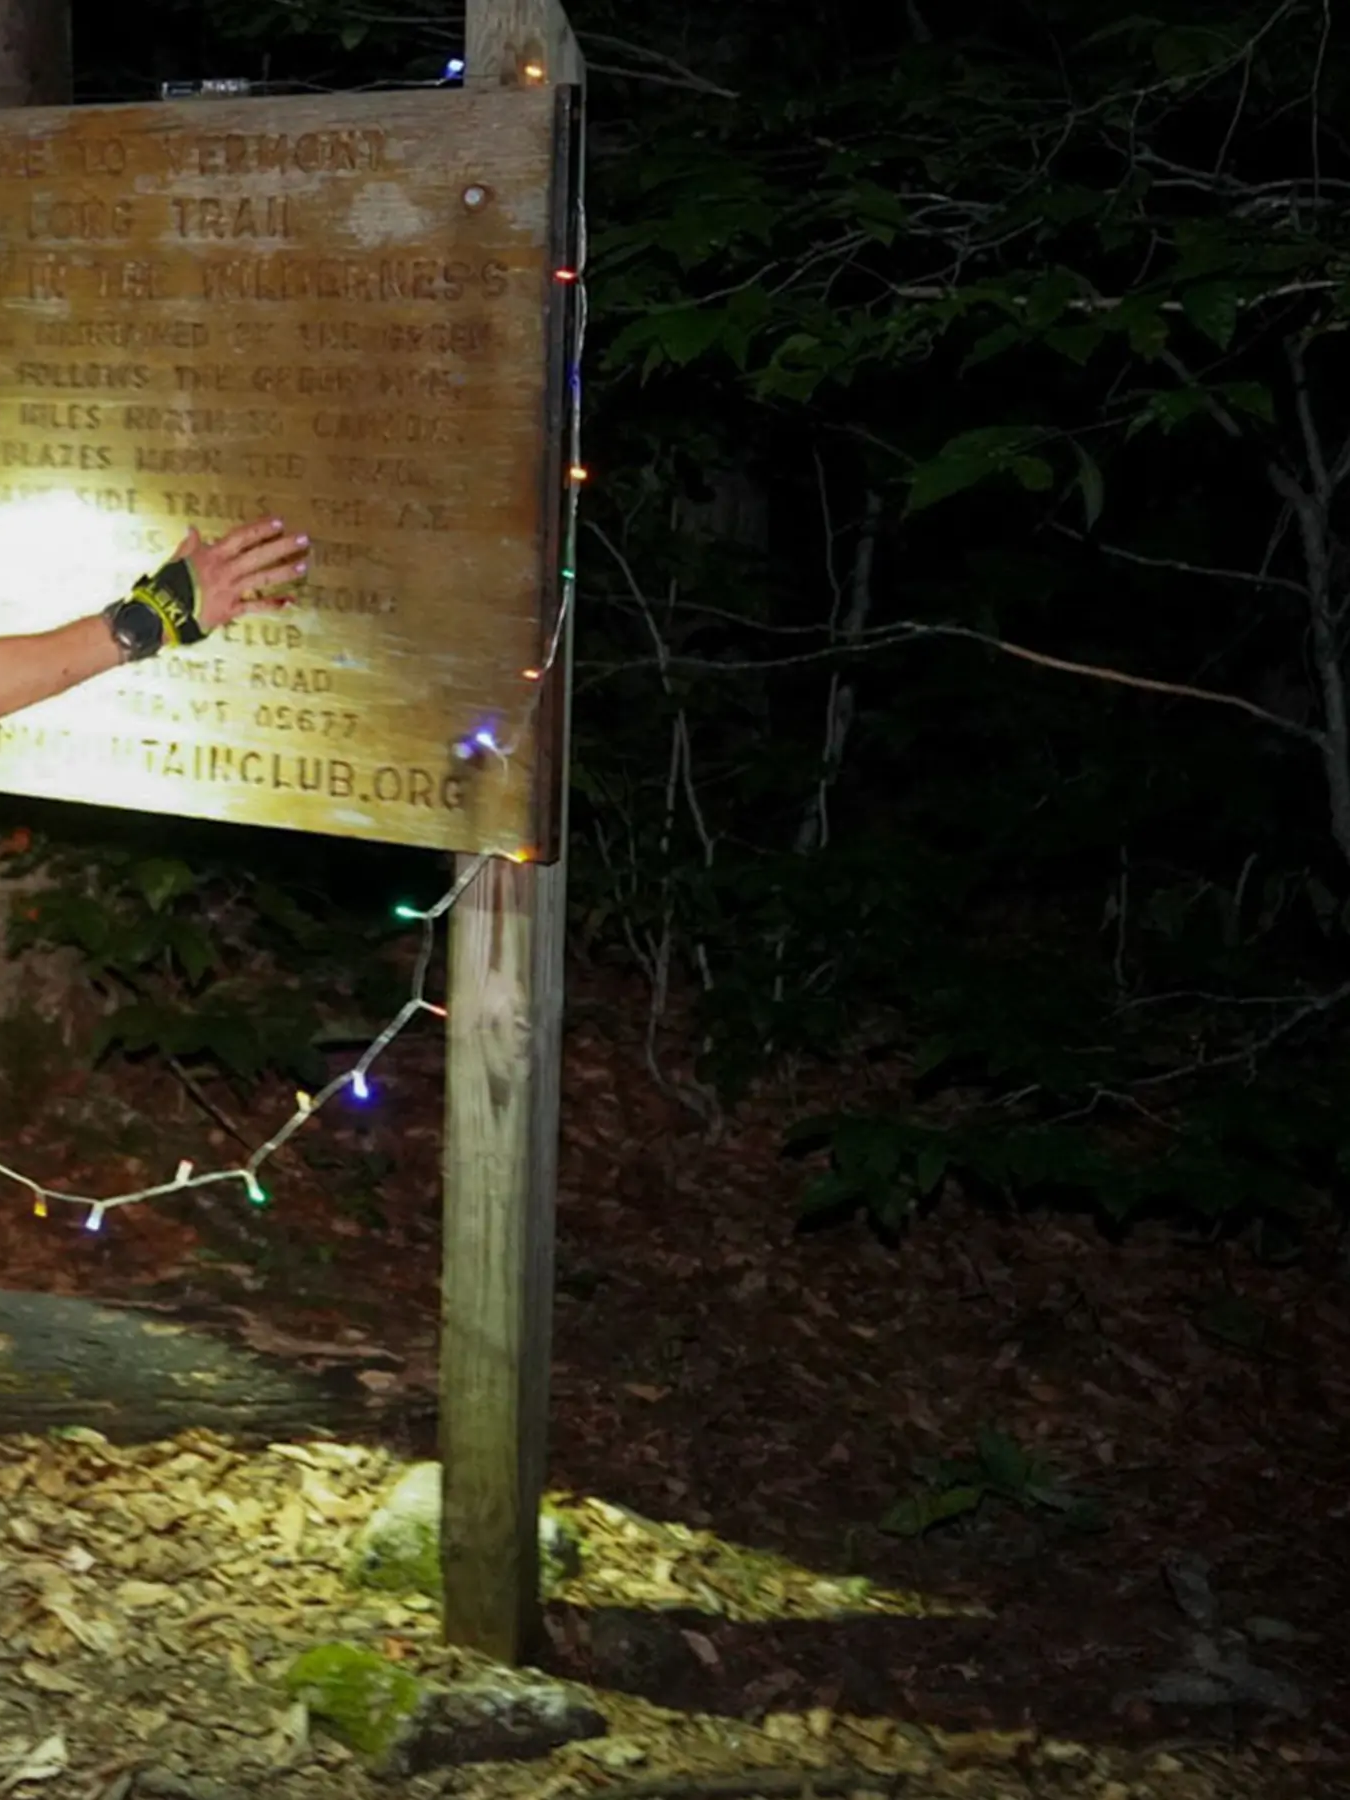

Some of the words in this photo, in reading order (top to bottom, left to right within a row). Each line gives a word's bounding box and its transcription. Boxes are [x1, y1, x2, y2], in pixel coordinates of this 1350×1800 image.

[160, 129, 389, 177] VERMONT
[24, 197, 134, 241] LONG
[169, 196, 302, 240] TRAIL
[16, 361, 150, 390] FOLLOWS
[19, 402, 100, 430] MILES
[2, 441, 112, 471] BLAZES
[73, 487, 138, 515] SIDE
[222, 620, 304, 649] CLUB
[250, 663, 332, 694] ROAD
[255, 704, 360, 740] 05677
